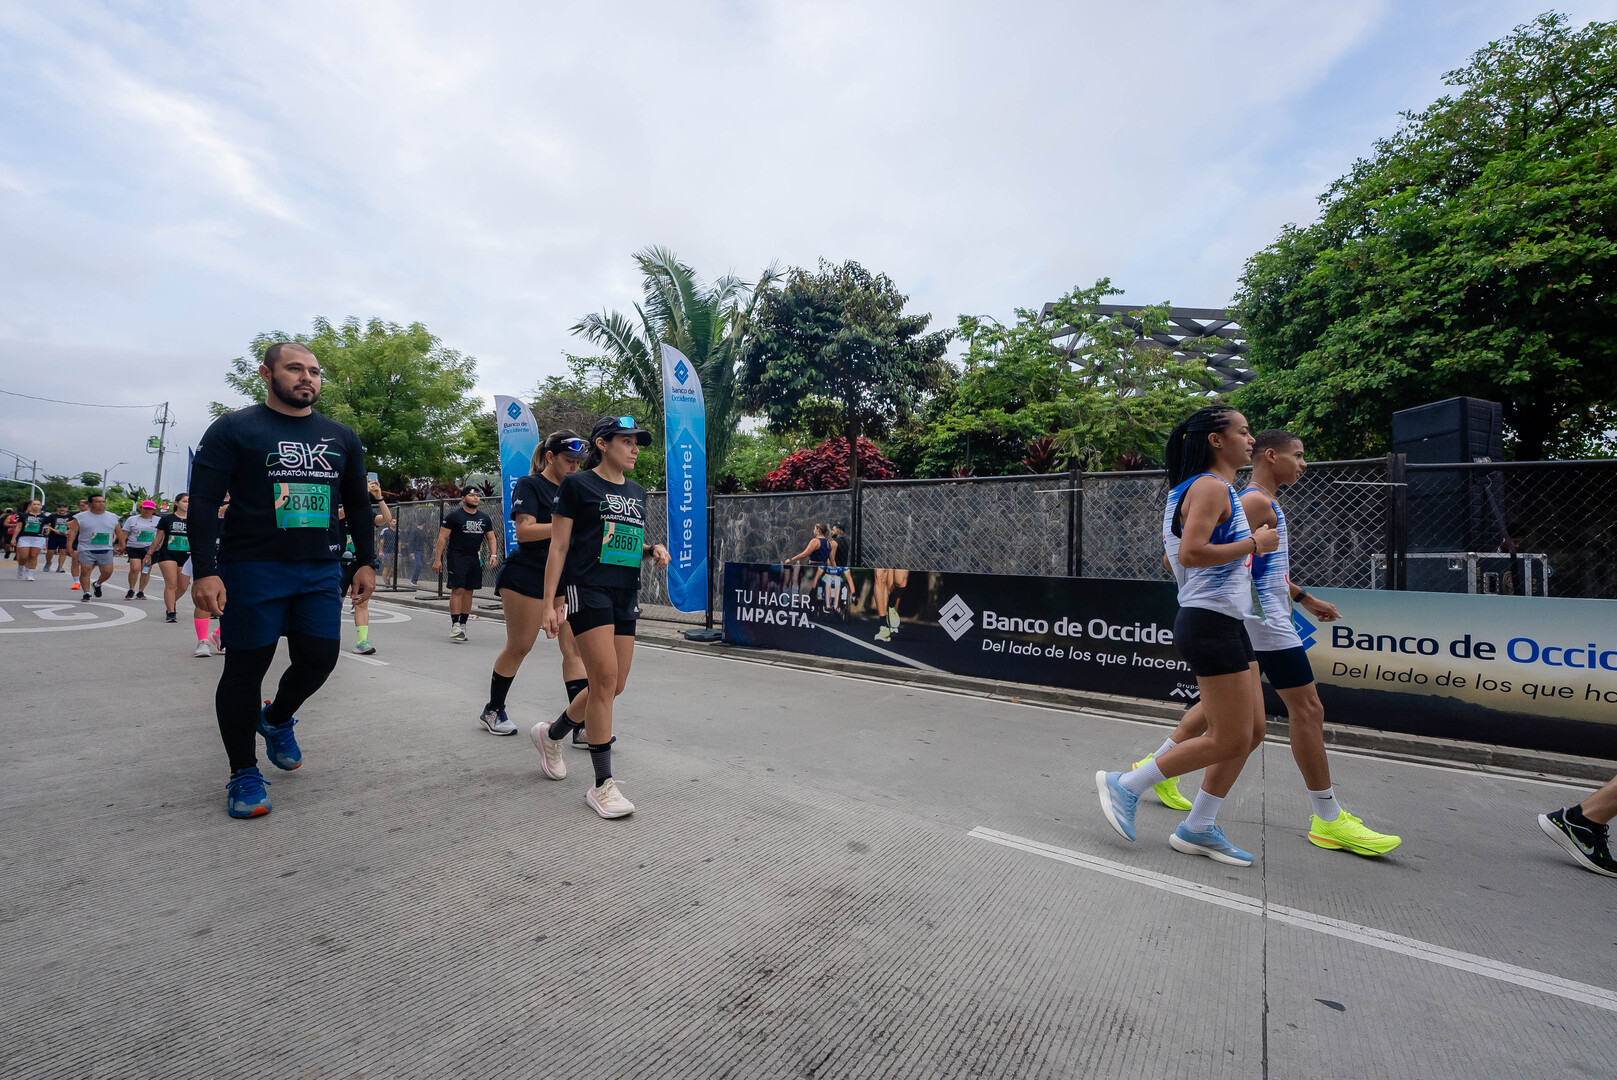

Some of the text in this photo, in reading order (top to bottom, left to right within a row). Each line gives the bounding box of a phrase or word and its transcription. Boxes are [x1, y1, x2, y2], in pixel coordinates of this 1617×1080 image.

[671, 395, 697, 403] Occidente
[278, 441, 333, 471] 5K
[268, 469, 308, 477] MARATÓN
[282, 495, 325, 511] 28482
[605, 493, 642, 518] 5K
[679, 443, 693, 569] ¡Eres fuerte!
[607, 533, 638, 551] 28587
[735, 589, 815, 612] TU HACER,
[736, 606, 815, 628] IMPACTA.
[982, 610, 1174, 645] Banco de Occide
[1332, 625, 1440, 656] Banco
[1449, 634, 1496, 660] de
[982, 639, 1192, 672] Del lado de los que hacen.
[1176, 682, 1200, 690] Grupo
[1332, 662, 1369, 678] Del
[1375, 664, 1428, 684] lado
[1435, 670, 1466, 688] de
[1475, 673, 1512, 692] los
[1521, 683, 1574, 700] que
